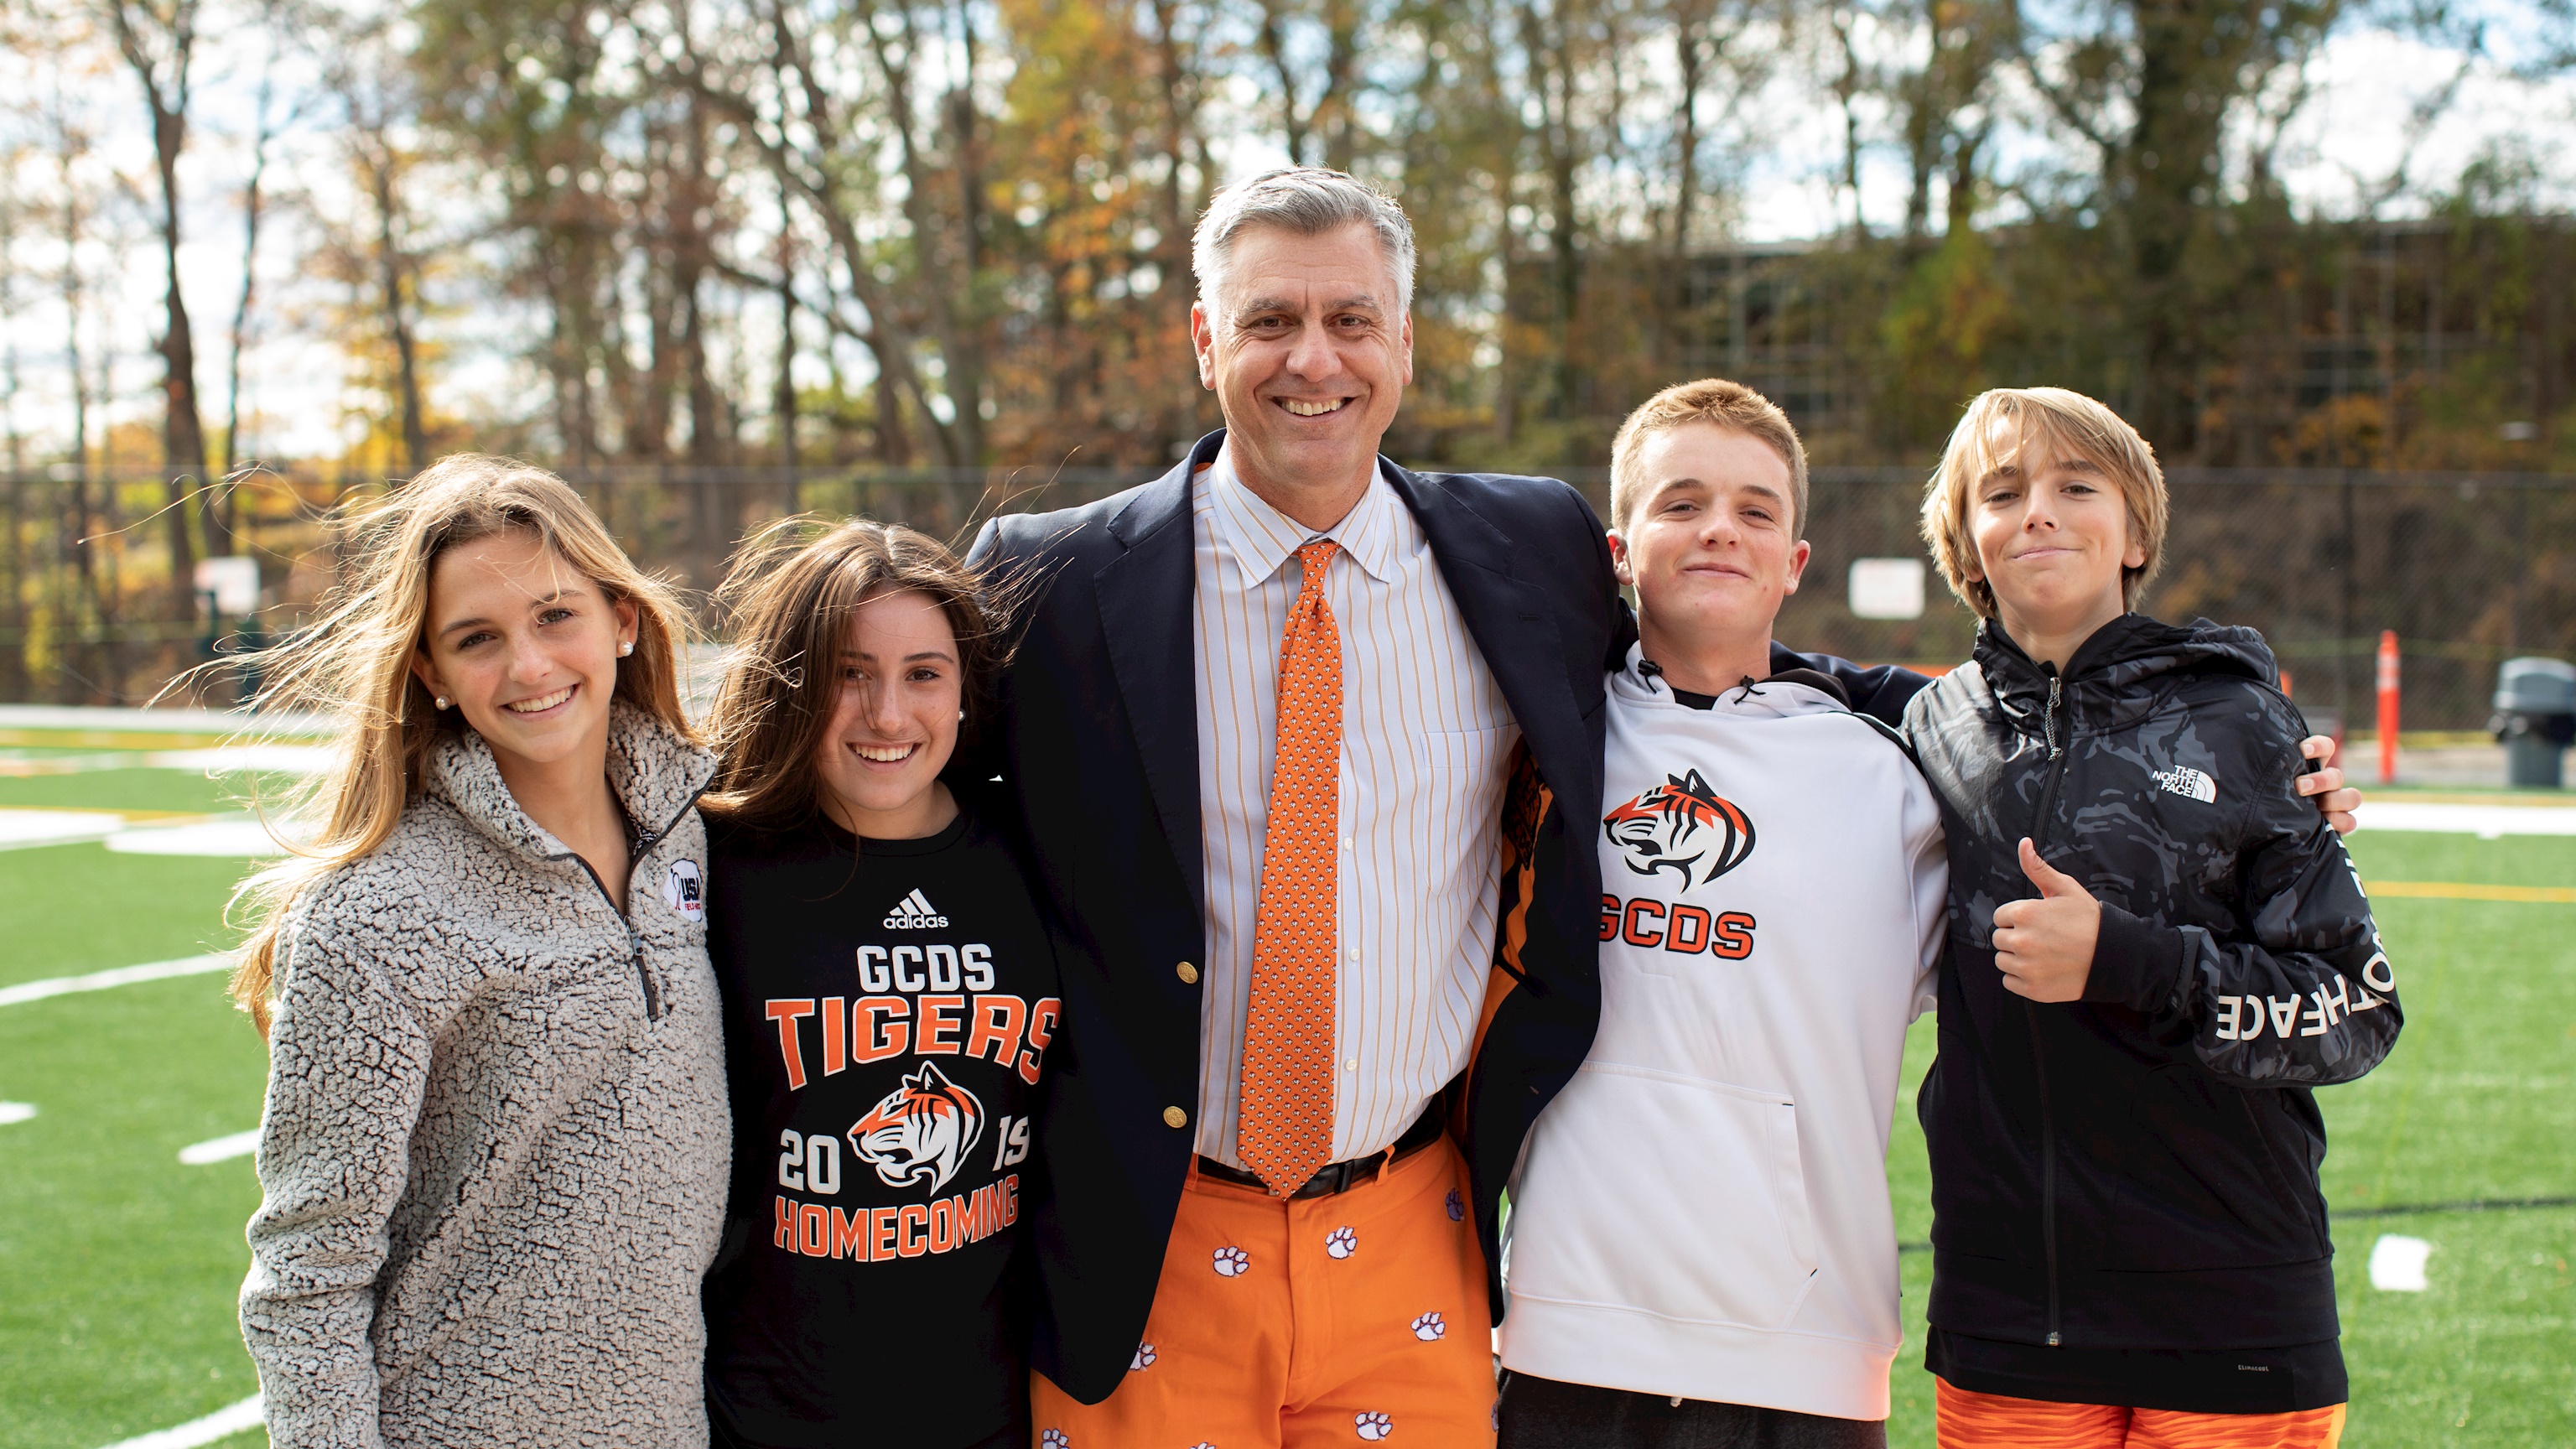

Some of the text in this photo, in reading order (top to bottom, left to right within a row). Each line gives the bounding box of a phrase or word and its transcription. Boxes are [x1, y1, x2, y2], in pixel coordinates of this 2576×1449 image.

[2152, 770, 2197, 788] NORTH
[2161, 781, 2193, 797] FACE
[2174, 765, 2199, 779] THE
[883, 914, 948, 929] adidas
[856, 943, 995, 993] GCDS
[2215, 991, 2328, 1041] FACE
[765, 995, 1062, 1091] TIGERS
[778, 1115, 1030, 1195] 20 19
[774, 1174, 1019, 1263] HOMECOMING
